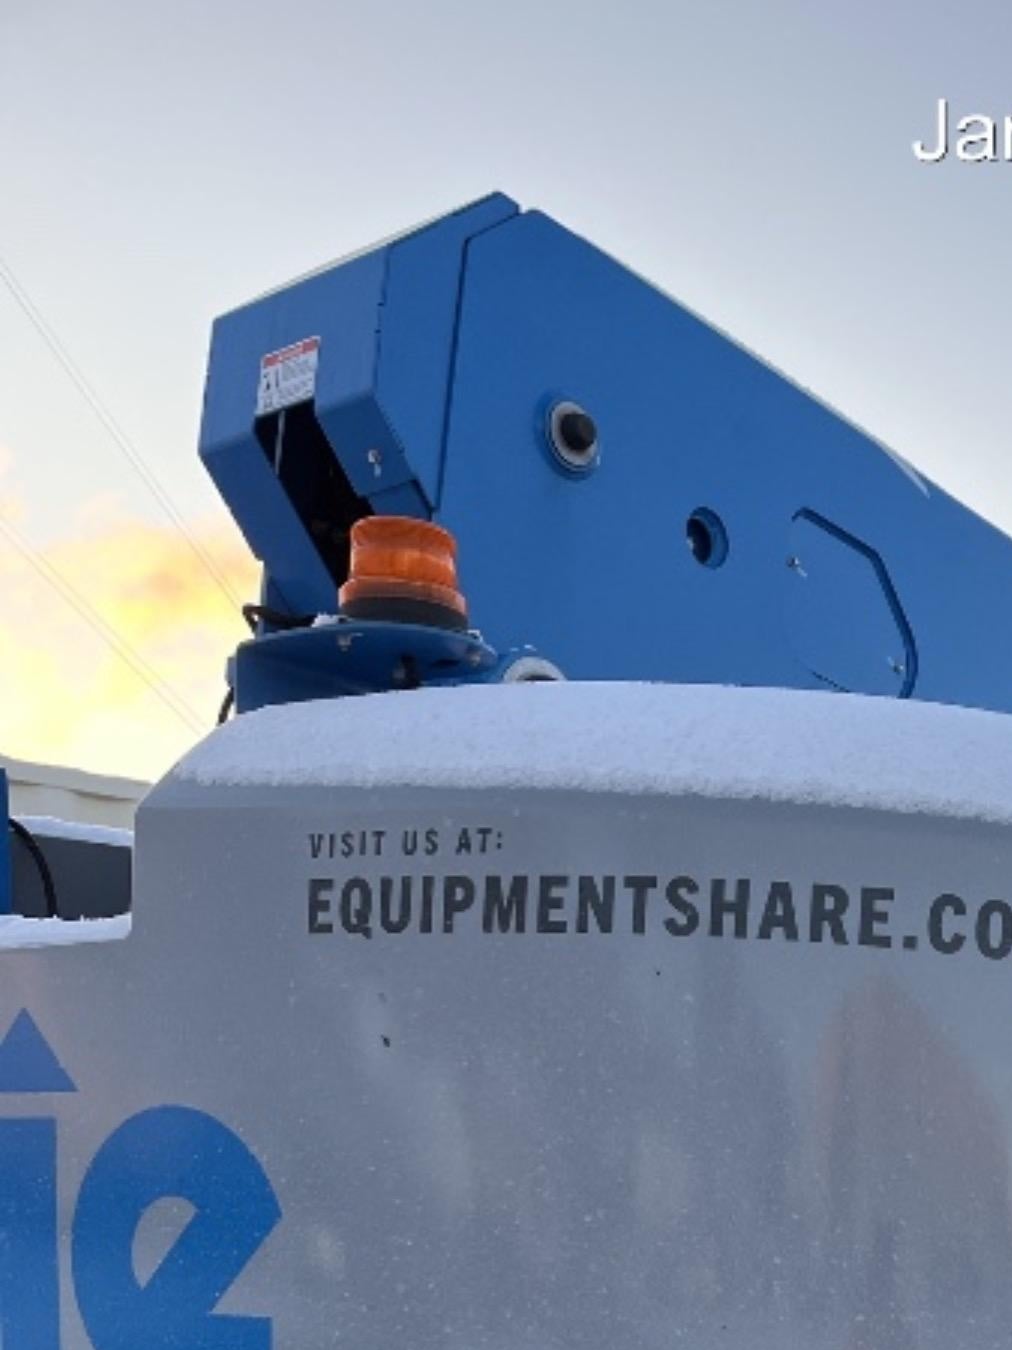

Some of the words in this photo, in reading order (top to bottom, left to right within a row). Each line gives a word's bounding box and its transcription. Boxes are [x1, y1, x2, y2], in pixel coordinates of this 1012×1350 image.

[309, 830, 386, 859] VISIT
[402, 828, 439, 856] US
[456, 827, 503, 854] AT:
